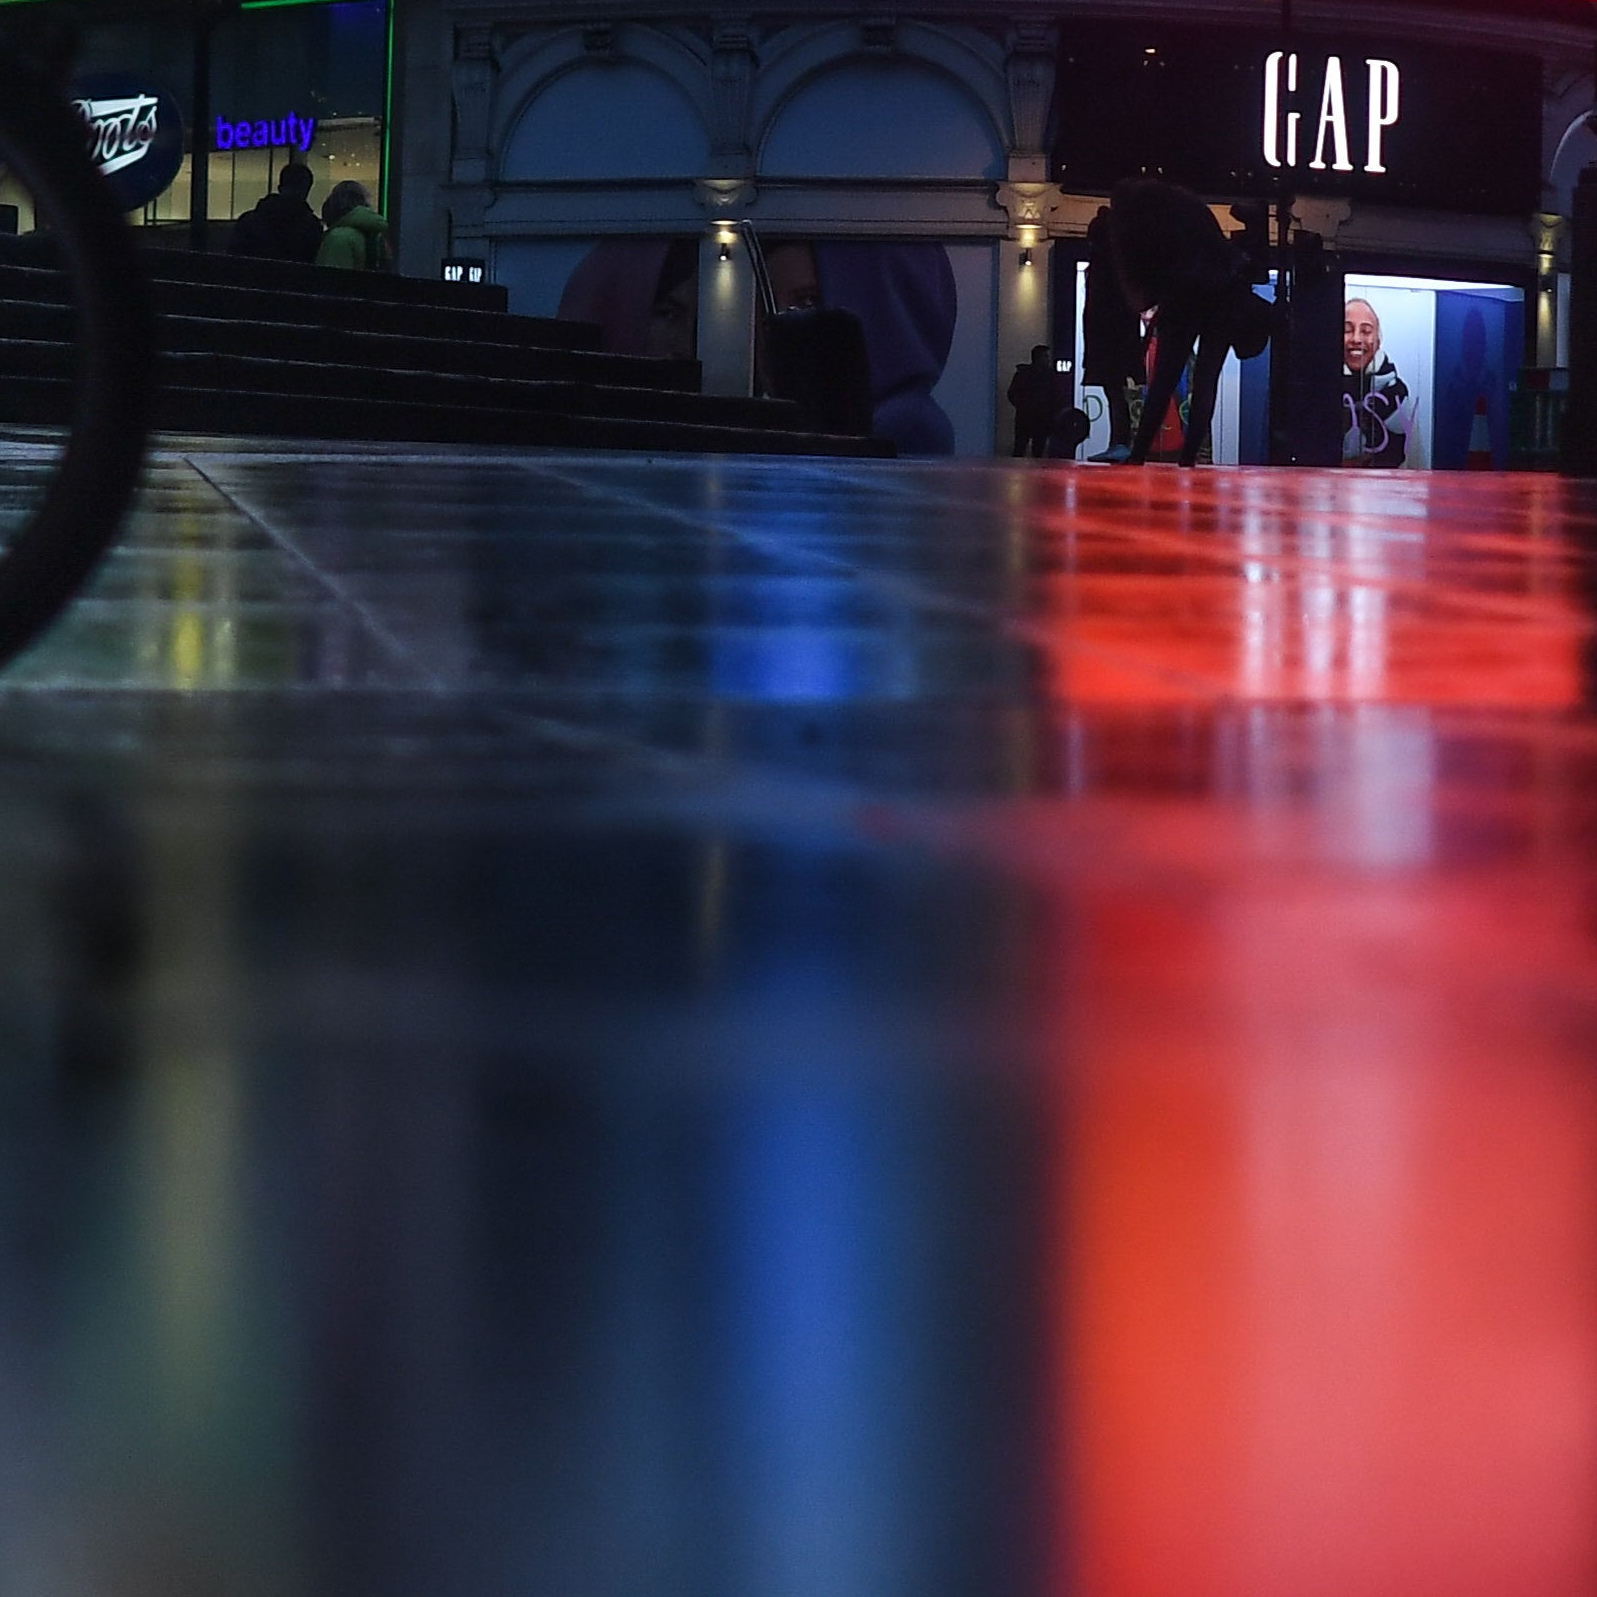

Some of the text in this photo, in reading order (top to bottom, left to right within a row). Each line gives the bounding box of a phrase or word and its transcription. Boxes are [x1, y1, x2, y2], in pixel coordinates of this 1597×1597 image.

[1262, 49, 1402, 174] GAP
[215, 110, 314, 152] beauty
[444, 265, 464, 282] GAP
[1056, 359, 1073, 372] GAP
